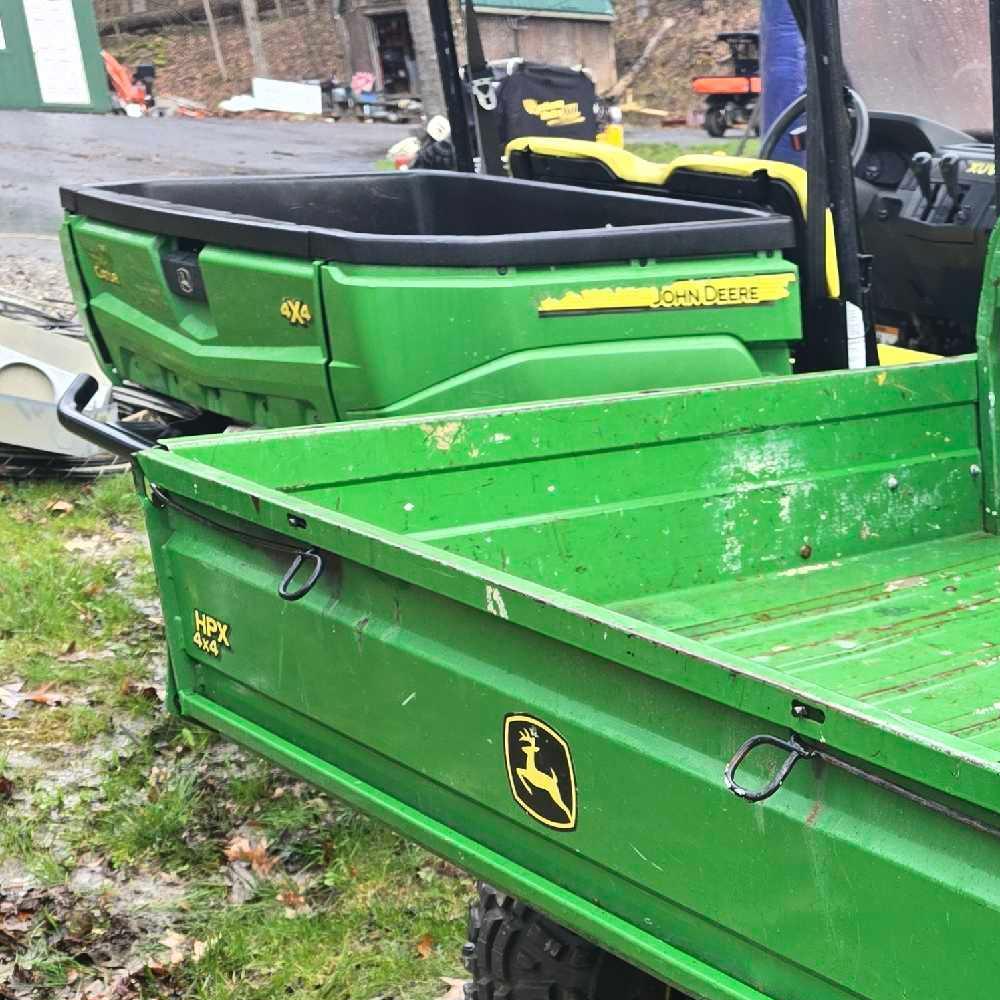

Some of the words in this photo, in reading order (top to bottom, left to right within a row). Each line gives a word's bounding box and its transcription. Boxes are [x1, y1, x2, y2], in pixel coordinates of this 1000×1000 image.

[653, 287, 699, 305] JOHN
[705, 285, 759, 302] DEERE
[194, 609, 230, 647] HPX
